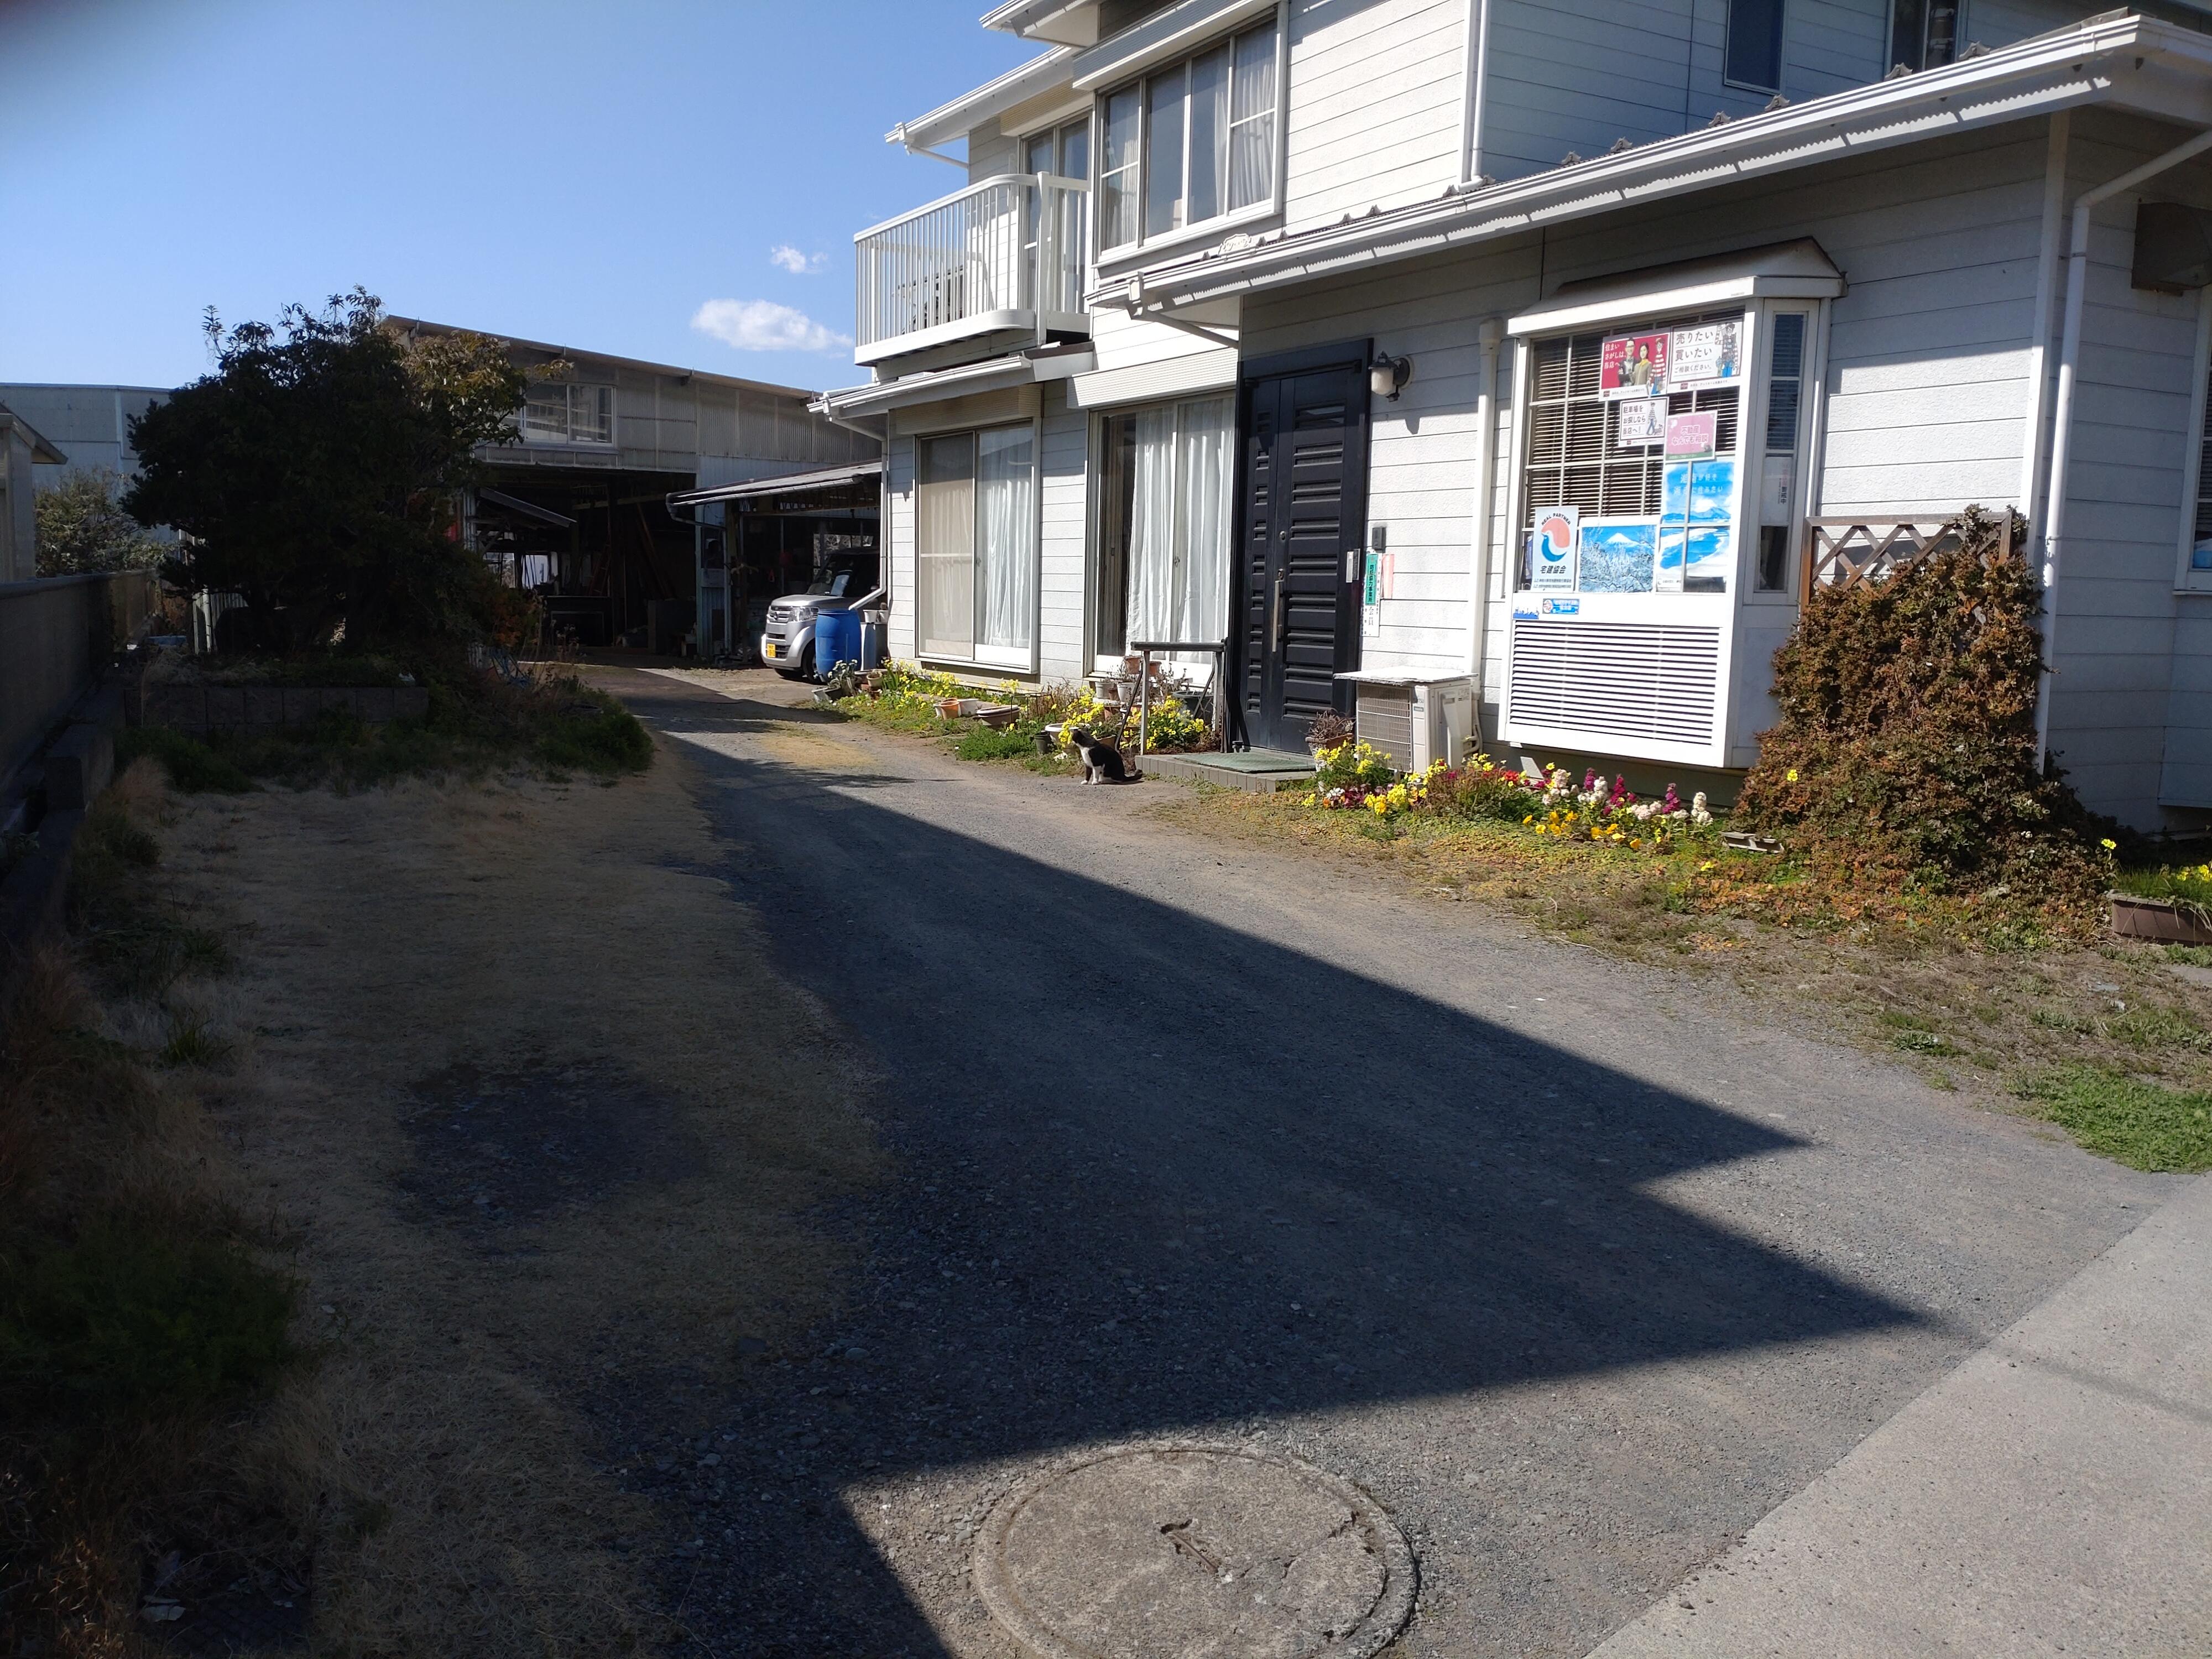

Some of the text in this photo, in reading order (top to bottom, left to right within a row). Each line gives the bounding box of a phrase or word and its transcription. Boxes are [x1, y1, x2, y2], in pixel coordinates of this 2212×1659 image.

[1676, 331, 1713, 345] 売りたい
[1605, 343, 1620, 351] 住まい
[1675, 347, 1712, 362] 買いたい
[1604, 361, 1620, 369] 当店へ
[1623, 404, 1644, 414] 駐車場を
[1623, 415, 1646, 424] お探しなら
[1681, 424, 1700, 435] 不動産
[1672, 434, 1708, 445] なんでも相談
[1541, 513, 1571, 525] REAL PARTNER
[1540, 566, 1566, 574] 宅建協会
